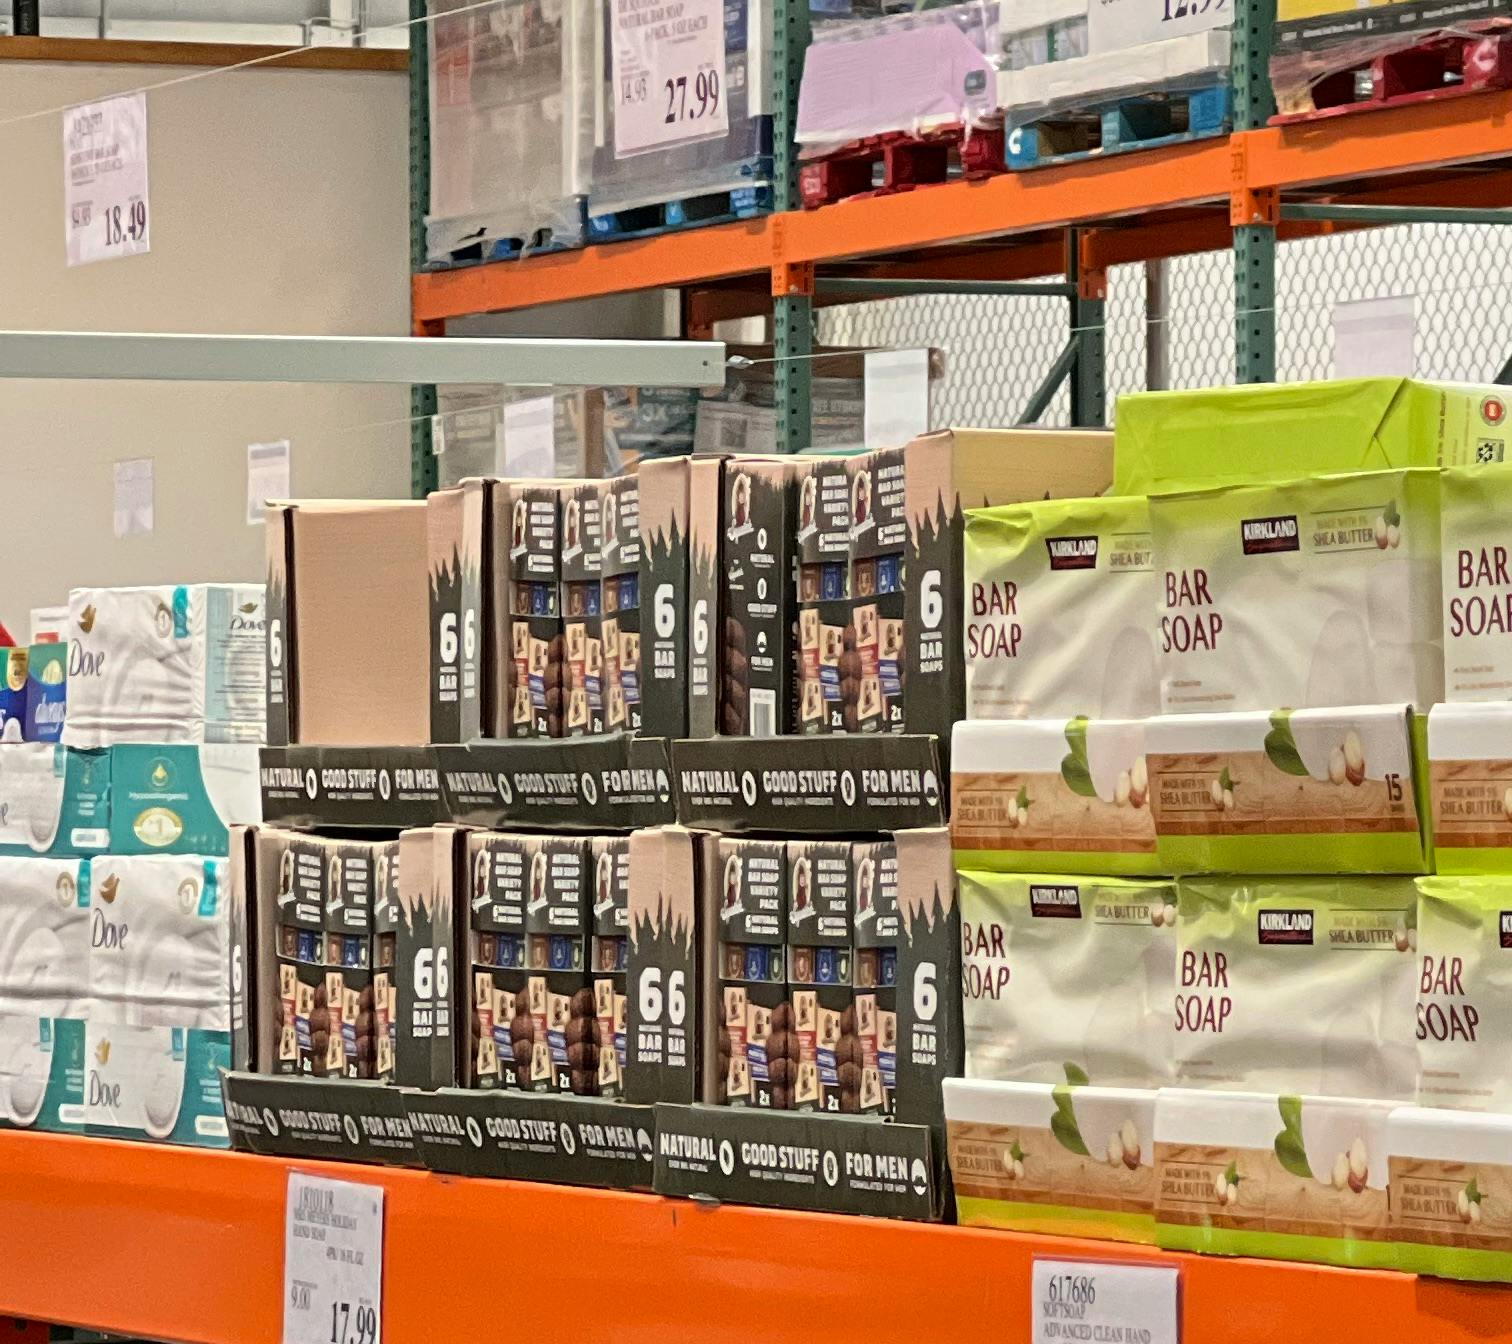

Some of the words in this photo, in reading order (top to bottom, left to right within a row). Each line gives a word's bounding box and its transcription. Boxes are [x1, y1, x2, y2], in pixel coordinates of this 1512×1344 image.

[664, 69, 719, 124] 27.99
[106, 201, 145, 245] 18.49
[1244, 520, 1297, 540] KIRKLAND
[1337, 528, 1374, 545] BUTTER
[1458, 546, 1510, 589] BAR
[921, 570, 942, 628] 6
[1167, 569, 1212, 607] BAR
[1162, 613, 1222, 653] SOAP
[69, 639, 105, 678] Dove
[682, 770, 738, 794] NATURAL
[763, 770, 797, 793] GOOD
[800, 770, 837, 794] STUFF
[862, 769, 888, 792] FOR
[891, 769, 921, 792] MEN
[1182, 951, 1228, 988] BAR
[914, 962, 937, 1020] 6
[1175, 996, 1231, 1033] SOAP
[661, 1133, 716, 1162] NATURAL
[741, 1137, 777, 1168] GOOD
[779, 1141, 820, 1172] STUFF
[846, 1153, 873, 1178] FOR
[876, 1154, 908, 1181] MEN
[1049, 1275, 1095, 1305] 617686
[1043, 1323, 1091, 1341] ADVANCED
[1094, 1325, 1122, 1342] CLEAN
[1125, 1328, 1150, 1344] HAND
